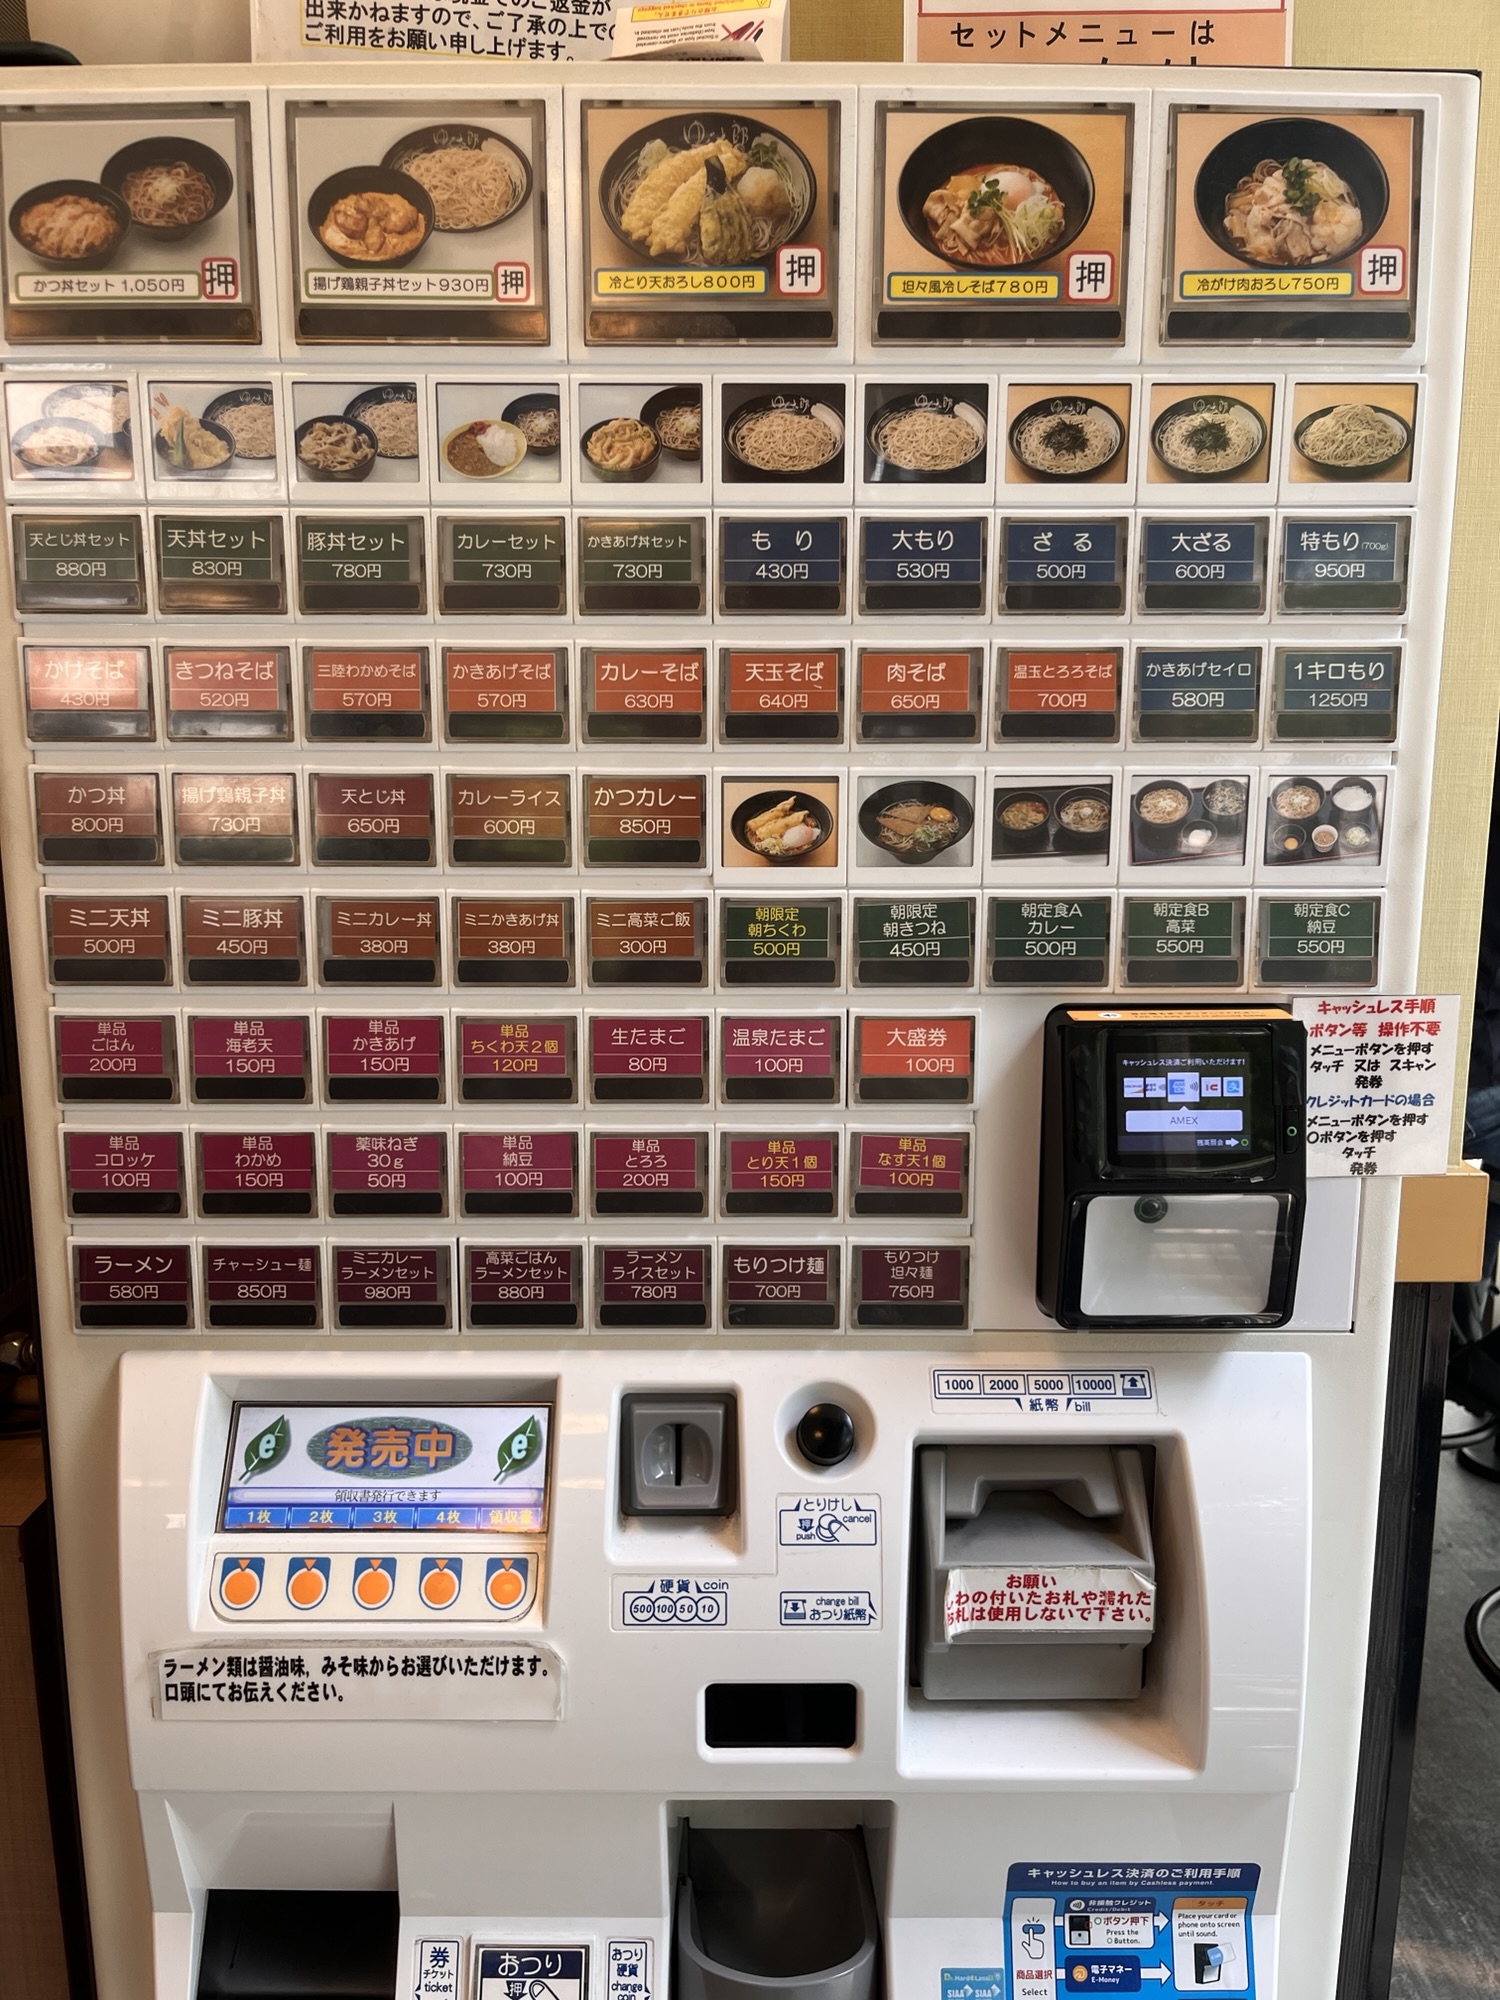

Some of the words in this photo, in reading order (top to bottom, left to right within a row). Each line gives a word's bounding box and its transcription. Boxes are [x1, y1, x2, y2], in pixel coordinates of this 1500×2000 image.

[305, 22, 575, 62] ご利用をお願い申し上げます。
[950, 20, 1216, 49] セットメニューは
[34, 279, 115, 293] かつ丼セット
[121, 279, 185, 293] 1,050円
[205, 262, 235, 295] 押
[501, 270, 524, 296] 押
[30, 532, 130, 549] 天とじ丼セット
[167, 528, 266, 550] 天丼セット
[307, 532, 405, 552] 豚丼セット
[457, 534, 556, 551] カレーセット
[588, 534, 688, 550] かきあげ丼セット
[891, 531, 951, 551] 大もり
[1171, 532, 1231, 552] 大ざる
[1300, 531, 1359, 552] 特もり
[56, 561, 106, 578] 880円
[45, 662, 124, 681] かけそば
[175, 661, 274, 681] きつねそば
[317, 663, 416, 679] 三陸わかめそば
[453, 663, 551, 681] かきあげそば
[601, 662, 698, 682] カレーそば
[745, 662, 824, 682] 天玉そば
[887, 663, 946, 683] 肉そば
[1014, 663, 1112, 680] 温玉とろろそば
[1146, 662, 1252, 678] かきあげセイロ
[1294, 663, 1384, 681] 1キロもり
[342, 692, 391, 708] 570円
[624, 694, 673, 709] 630円
[1038, 693, 1087, 708] 700円
[68, 786, 126, 805] かつ丼
[181, 787, 286, 804] 揚げ鶏親子丼
[341, 789, 405, 805] 天とじ丼
[458, 790, 562, 806] カレーライス
[595, 787, 697, 807] かつカレー
[71, 817, 123, 833] 800円
[755, 907, 799, 922] 朝限定
[1021, 903, 1082, 919] 朝定食A
[1153, 902, 1209, 918] 朝定食B
[1294, 903, 1350, 918] 朝定食C
[69, 908, 150, 928] ミニ天丼
[202, 908, 284, 929] ミニ豚丼
[336, 912, 432, 928] ミニカレー丼
[464, 912, 559, 927] ミニかきあげ丼
[596, 912, 691, 929] ミニ高菜ご飯
[748, 922, 806, 938] 朝ちくわ
[883, 921, 946, 937] 朝きつね
[1027, 920, 1075, 935] カレー
[1166, 919, 1196, 934] 高菜
[1307, 919, 1336, 934] 納豆
[360, 939, 408, 954] 380円
[753, 942, 800, 956] 500円
[1318, 998, 1436, 1014] キャッシュレス手順
[97, 1022, 127, 1037] 単品
[234, 1021, 264, 1037] 単品
[611, 1027, 685, 1046] 生たまご
[1309, 1023, 1367, 1038] ボタン等
[1378, 1021, 1441, 1037] 操作不要
[91, 1038, 135, 1052] ごはん
[352, 1036, 416, 1052] かきあげ
[732, 1028, 825, 1047] 温泉たまご
[887, 1028, 947, 1047] 大盛券
[226, 1038, 273, 1053] 海老天
[470, 1038, 559, 1055] ちくわ天2個
[1311, 1042, 1434, 1056] メニューボタンを押す
[89, 1058, 136, 1073] 200円
[1310, 1060, 1344, 1073] タッチ
[1354, 1059, 1380, 1072] 又は
[1390, 1058, 1436, 1072] スキャン
[1355, 1075, 1383, 1089] 発券
[1306, 1093, 1435, 1108] クレジットカードの場合
[1170, 1117, 1198, 1125] AMEX
[1307, 1113, 1428, 1127] メニューボタンを押す
[355, 1136, 417, 1153] 薬味ねぎ
[1342, 1146, 1376, 1159] タッチ
[95, 1153, 156, 1168] コロッケ
[235, 1153, 281, 1168] わかめ
[624, 1155, 668, 1169] とろろ
[747, 1155, 817, 1170] とり天1個
[877, 1153, 946, 1169] なす天1個
[1350, 1162, 1377, 1175] 発券
[367, 1173, 406, 1188] 50円
[494, 1172, 543, 1187] 100円
[623, 1173, 669, 1188] 200円
[352, 1250, 423, 1265] ミニカレー
[485, 1251, 557, 1266] 高菜ごはん
[884, 1250, 940, 1264] もりつけ
[94, 1255, 174, 1275] ラーメン
[213, 1257, 312, 1273] チャーシュー麺
[734, 1256, 825, 1275] もりつけ麺
[341, 1266, 434, 1280] ラーメンセット
[612, 1266, 696, 1280] ライスセット
[888, 1284, 934, 1299] 750円
[945, 1380, 974, 1390] 1000
[989, 1380, 1019, 1390] 2000
[1034, 1380, 1064, 1390] 5000
[1076, 1380, 1112, 1390] 10000
[1029, 1399, 1059, 1411] 紙幣
[1075, 1402, 1091, 1412] bill
[325, 1426, 454, 1470] 発売中
[335, 1489, 442, 1503] 領収書発行できます
[804, 1498, 852, 1511] とりけし
[247, 1510, 271, 1523] 1枚
[309, 1510, 334, 1524] 2枚
[373, 1510, 398, 1524] 3枚
[436, 1510, 461, 1524] 4枚
[843, 1514, 871, 1522] cancel
[796, 1532, 815, 1540] push
[660, 1579, 690, 1593] 硬貨
[1006, 1574, 1057, 1588] お願い
[816, 1596, 845, 1606] change
[848, 1597, 859, 1605] bill
[633, 1605, 652, 1613] 500
[657, 1605, 673, 1613] 100
[679, 1605, 693, 1613] 50
[702, 1605, 713, 1613] 10
[810, 1609, 866, 1620] おつり紙幣
[164, 1682, 345, 1703] 口頭にてお伝えください。
[1027, 1868, 1241, 1879] キャッシュレス決済のご利用手順
[430, 1946, 449, 1967] 券
[612, 1948, 643, 1961] おつり
[498, 1954, 562, 1977] おつり
[617, 1963, 638, 1977] 硬貨
[1091, 1965, 1132, 1974] 電子マネー
[424, 1969, 453, 1979] チケット
[1016, 1970, 1052, 1979] 商品選択
[425, 1982, 453, 1993] ticket
[611, 1981, 642, 1994] change
